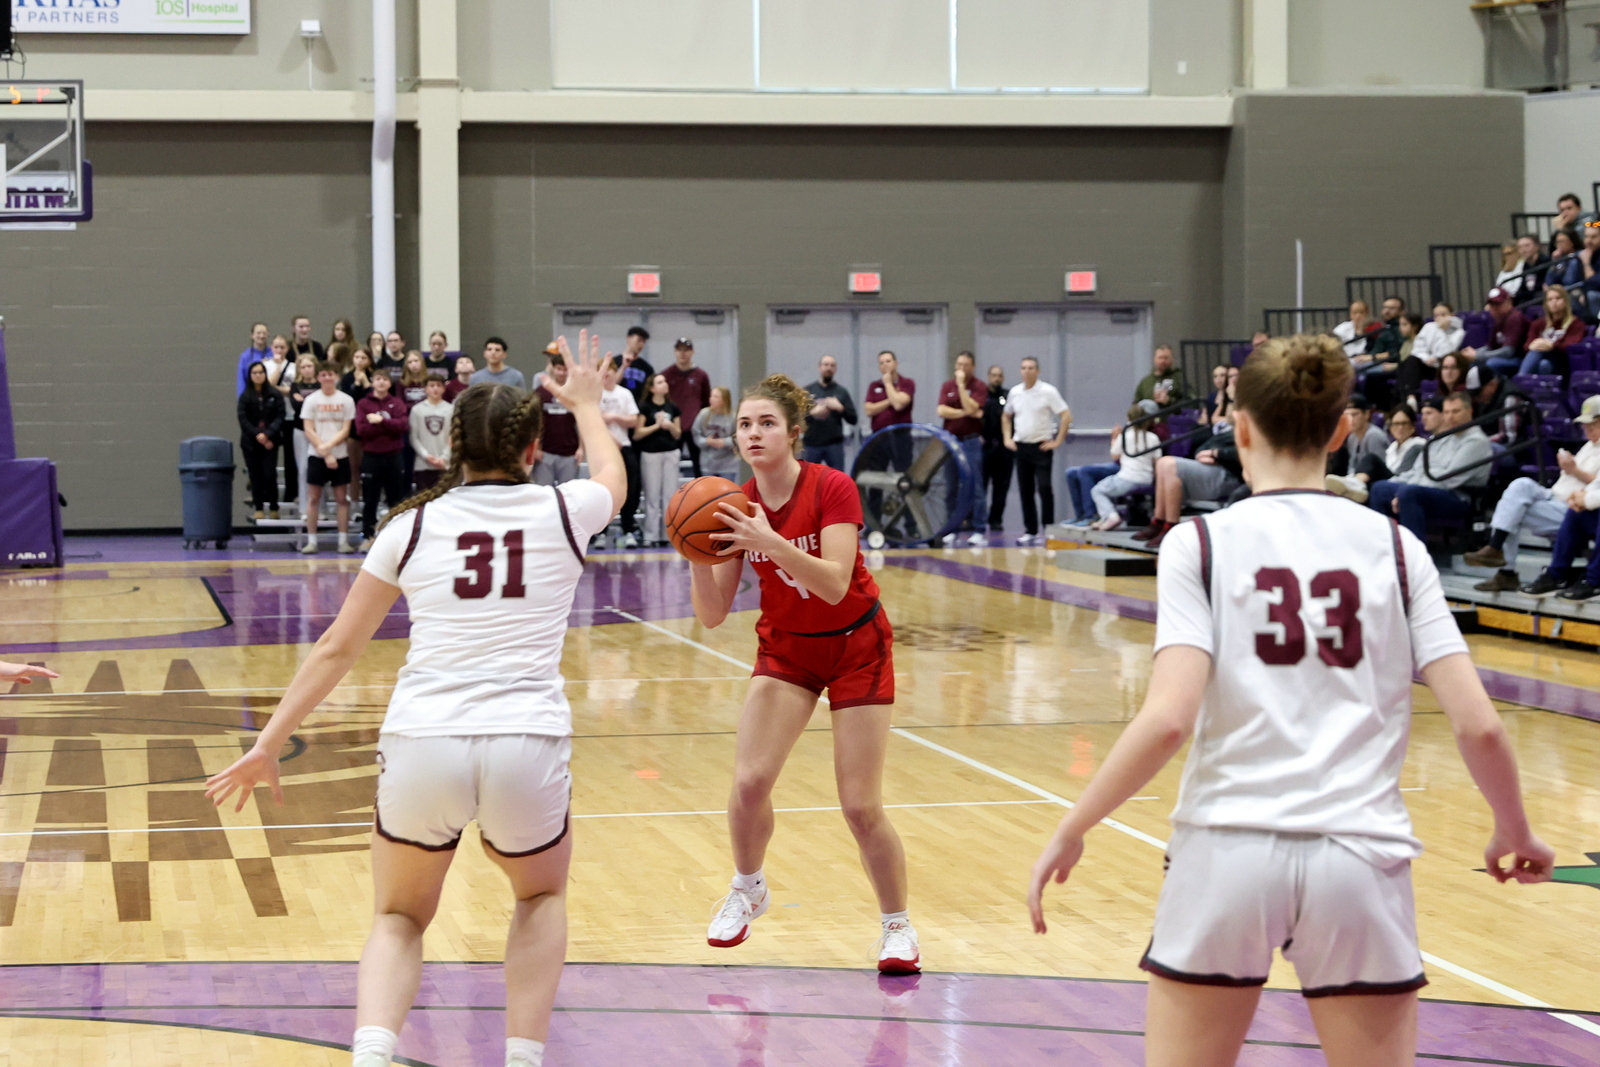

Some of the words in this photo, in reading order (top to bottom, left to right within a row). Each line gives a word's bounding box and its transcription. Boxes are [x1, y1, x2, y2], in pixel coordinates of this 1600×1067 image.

[27, 11, 119, 23] PARTNERS
[191, 3, 239, 15] Hospital
[453, 529, 526, 599] 31
[1254, 566, 1363, 669] 33
